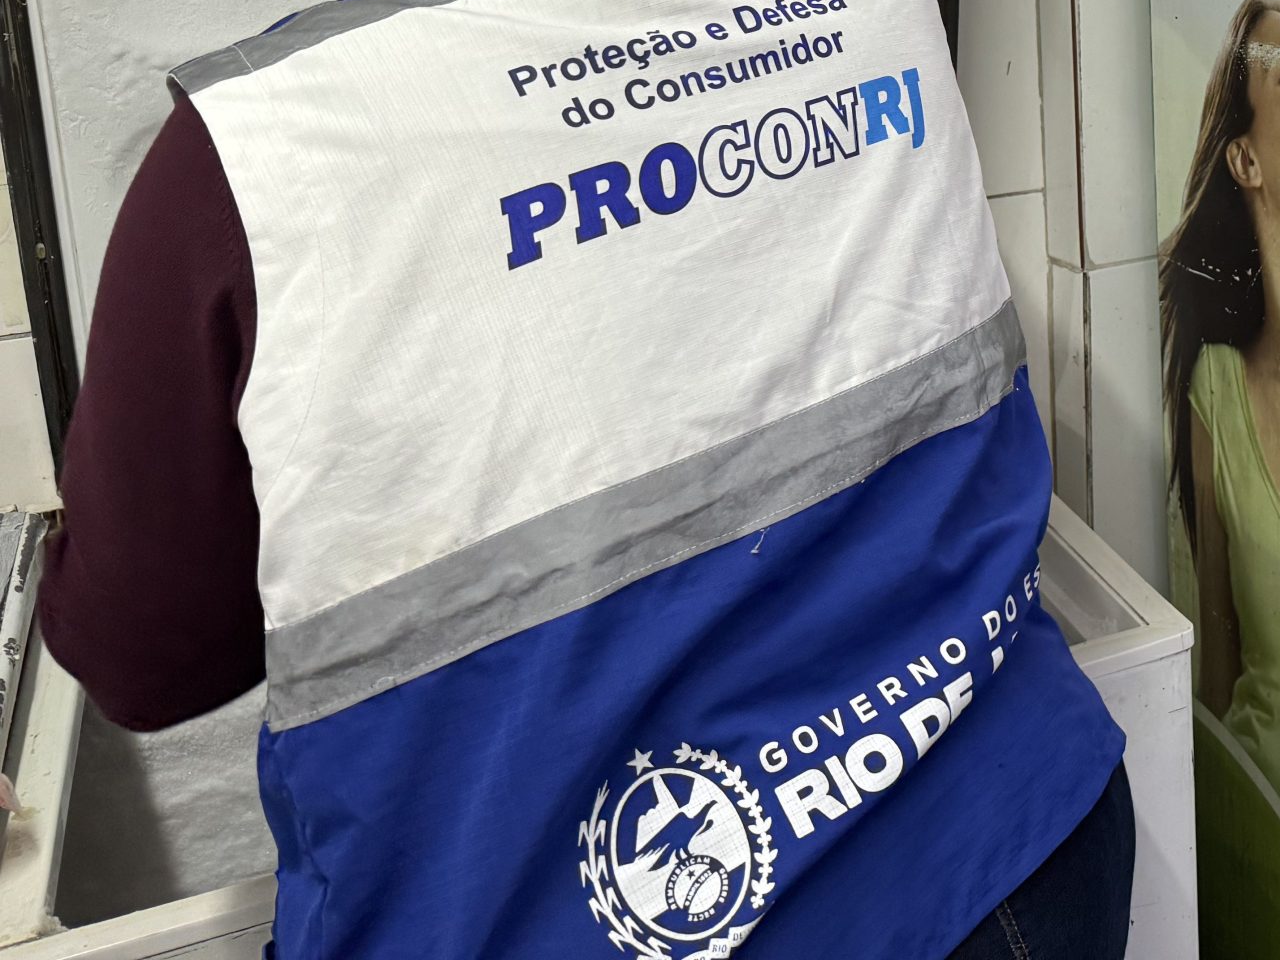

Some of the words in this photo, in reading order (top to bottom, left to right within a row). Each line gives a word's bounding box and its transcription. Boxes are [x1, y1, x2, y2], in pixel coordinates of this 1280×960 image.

[508, 29, 698, 96] Proteção
[705, 22, 729, 41] e
[561, 97, 615, 128] do
[624, 28, 845, 110] Consumidor
[500, 67, 926, 270] PROCONRJ
[759, 637, 968, 773] GOVERNO
[982, 594, 1017, 640] DO
[774, 733, 904, 839] RIO
